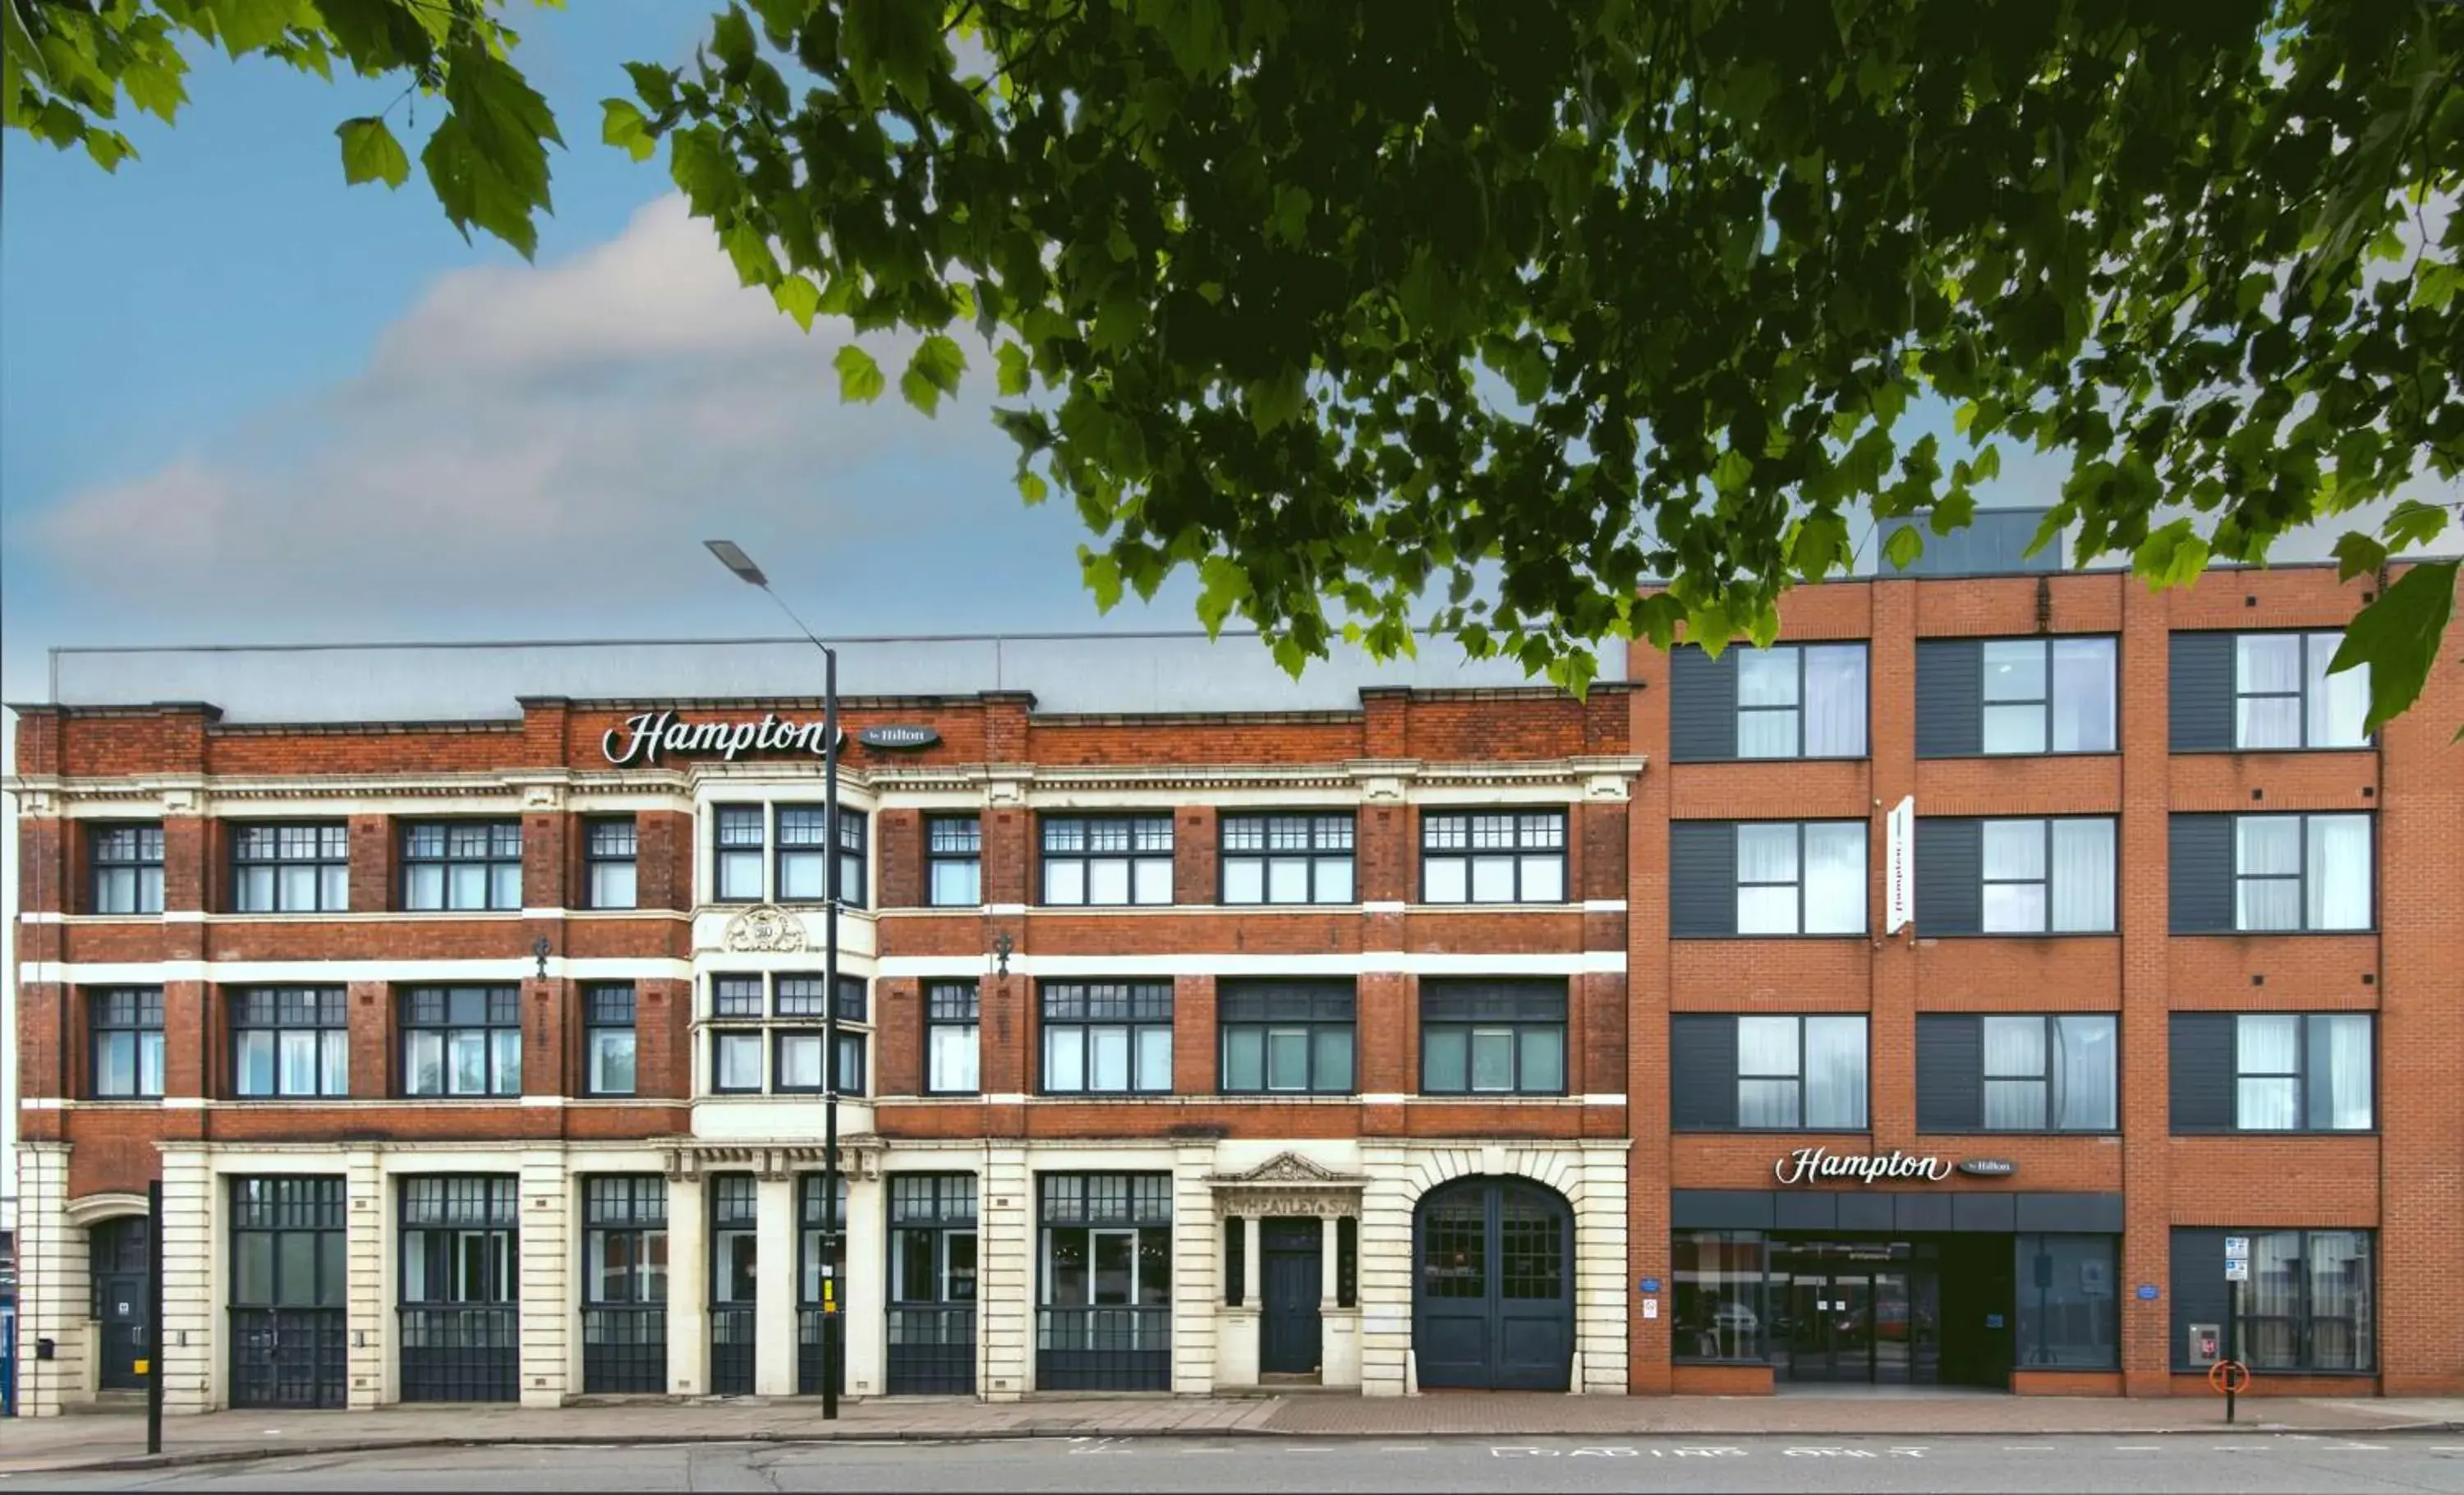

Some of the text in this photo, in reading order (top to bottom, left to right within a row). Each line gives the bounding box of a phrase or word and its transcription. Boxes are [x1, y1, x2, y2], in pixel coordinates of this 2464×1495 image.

[603, 709, 843, 764] Hampton
[882, 729, 925, 741] Hilton
[1775, 1145, 1952, 1184] Hampton
